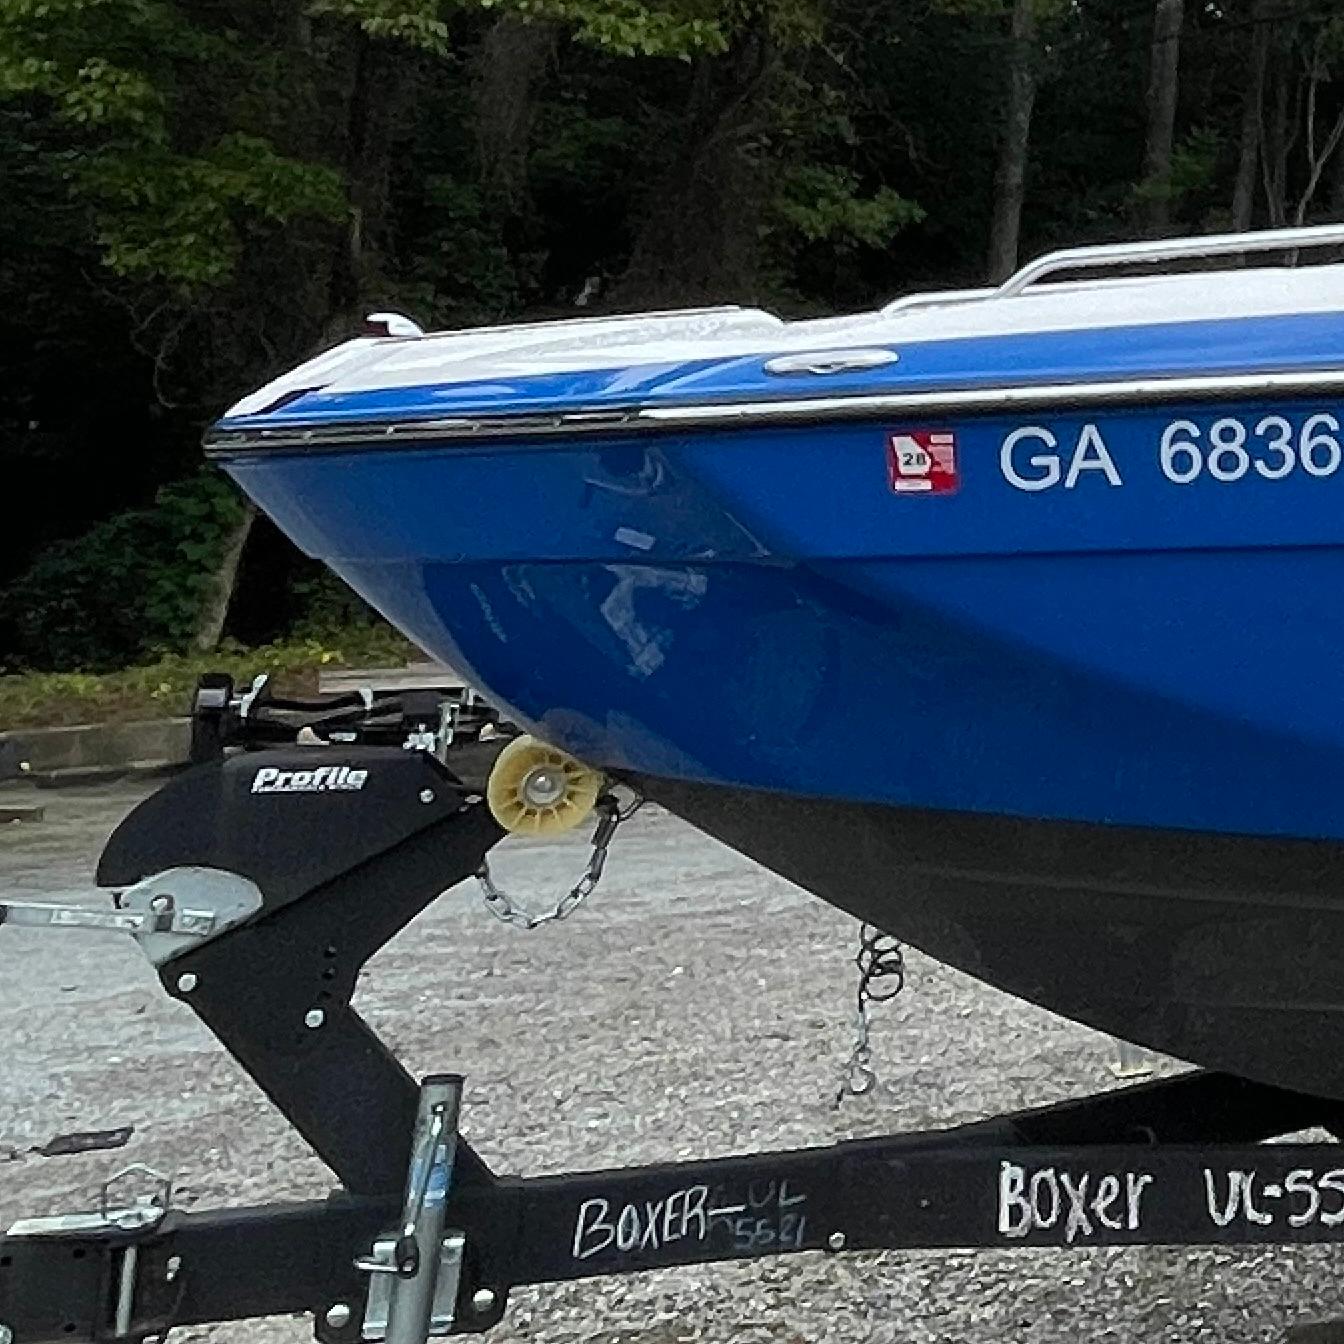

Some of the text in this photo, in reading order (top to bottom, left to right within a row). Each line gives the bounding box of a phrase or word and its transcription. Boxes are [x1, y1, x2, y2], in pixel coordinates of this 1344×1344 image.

[999, 423, 1123, 492] GA
[1159, 412, 1342, 484] 6836
[250, 765, 369, 793] Profile
